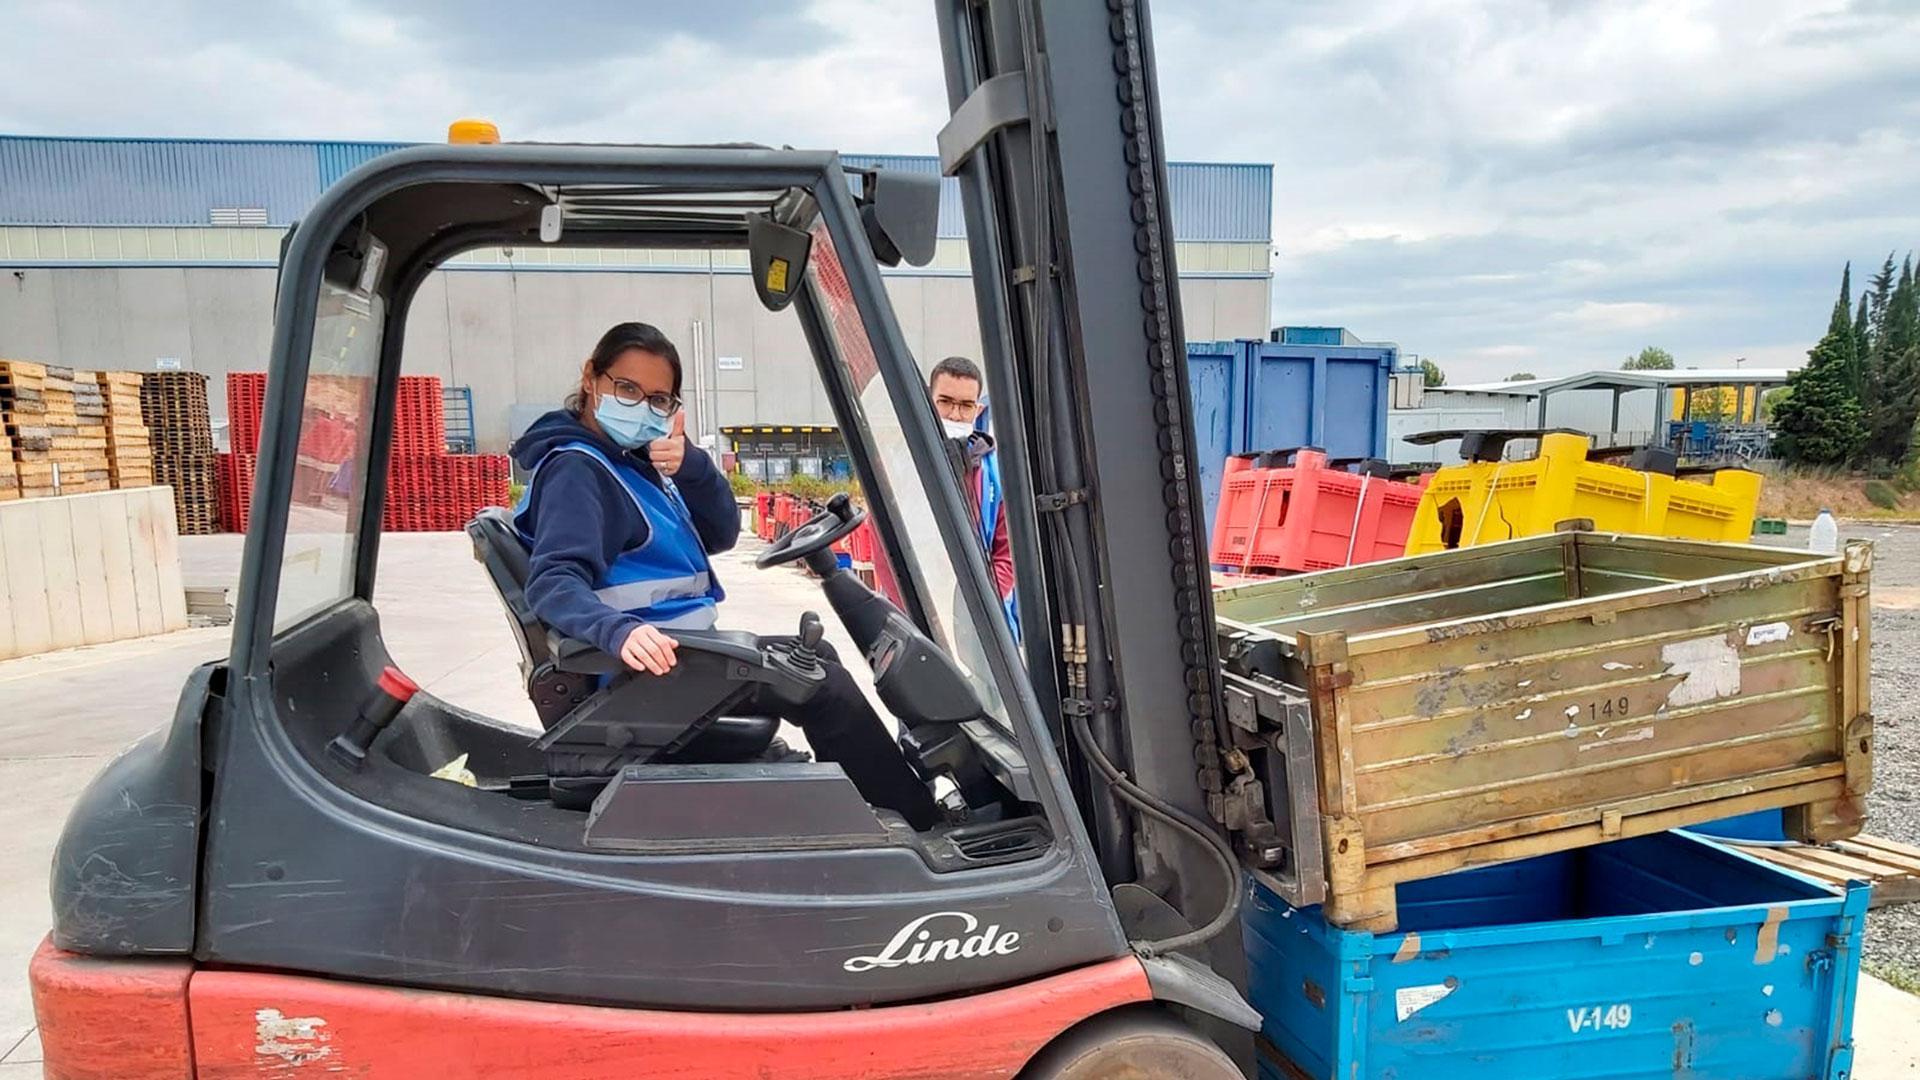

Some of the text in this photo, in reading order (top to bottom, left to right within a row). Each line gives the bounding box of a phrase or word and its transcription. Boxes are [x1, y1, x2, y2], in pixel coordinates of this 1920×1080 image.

[1589, 697, 1629, 720] 149
[843, 911, 1020, 972] Linde
[1567, 1003, 1632, 1033] V-149
